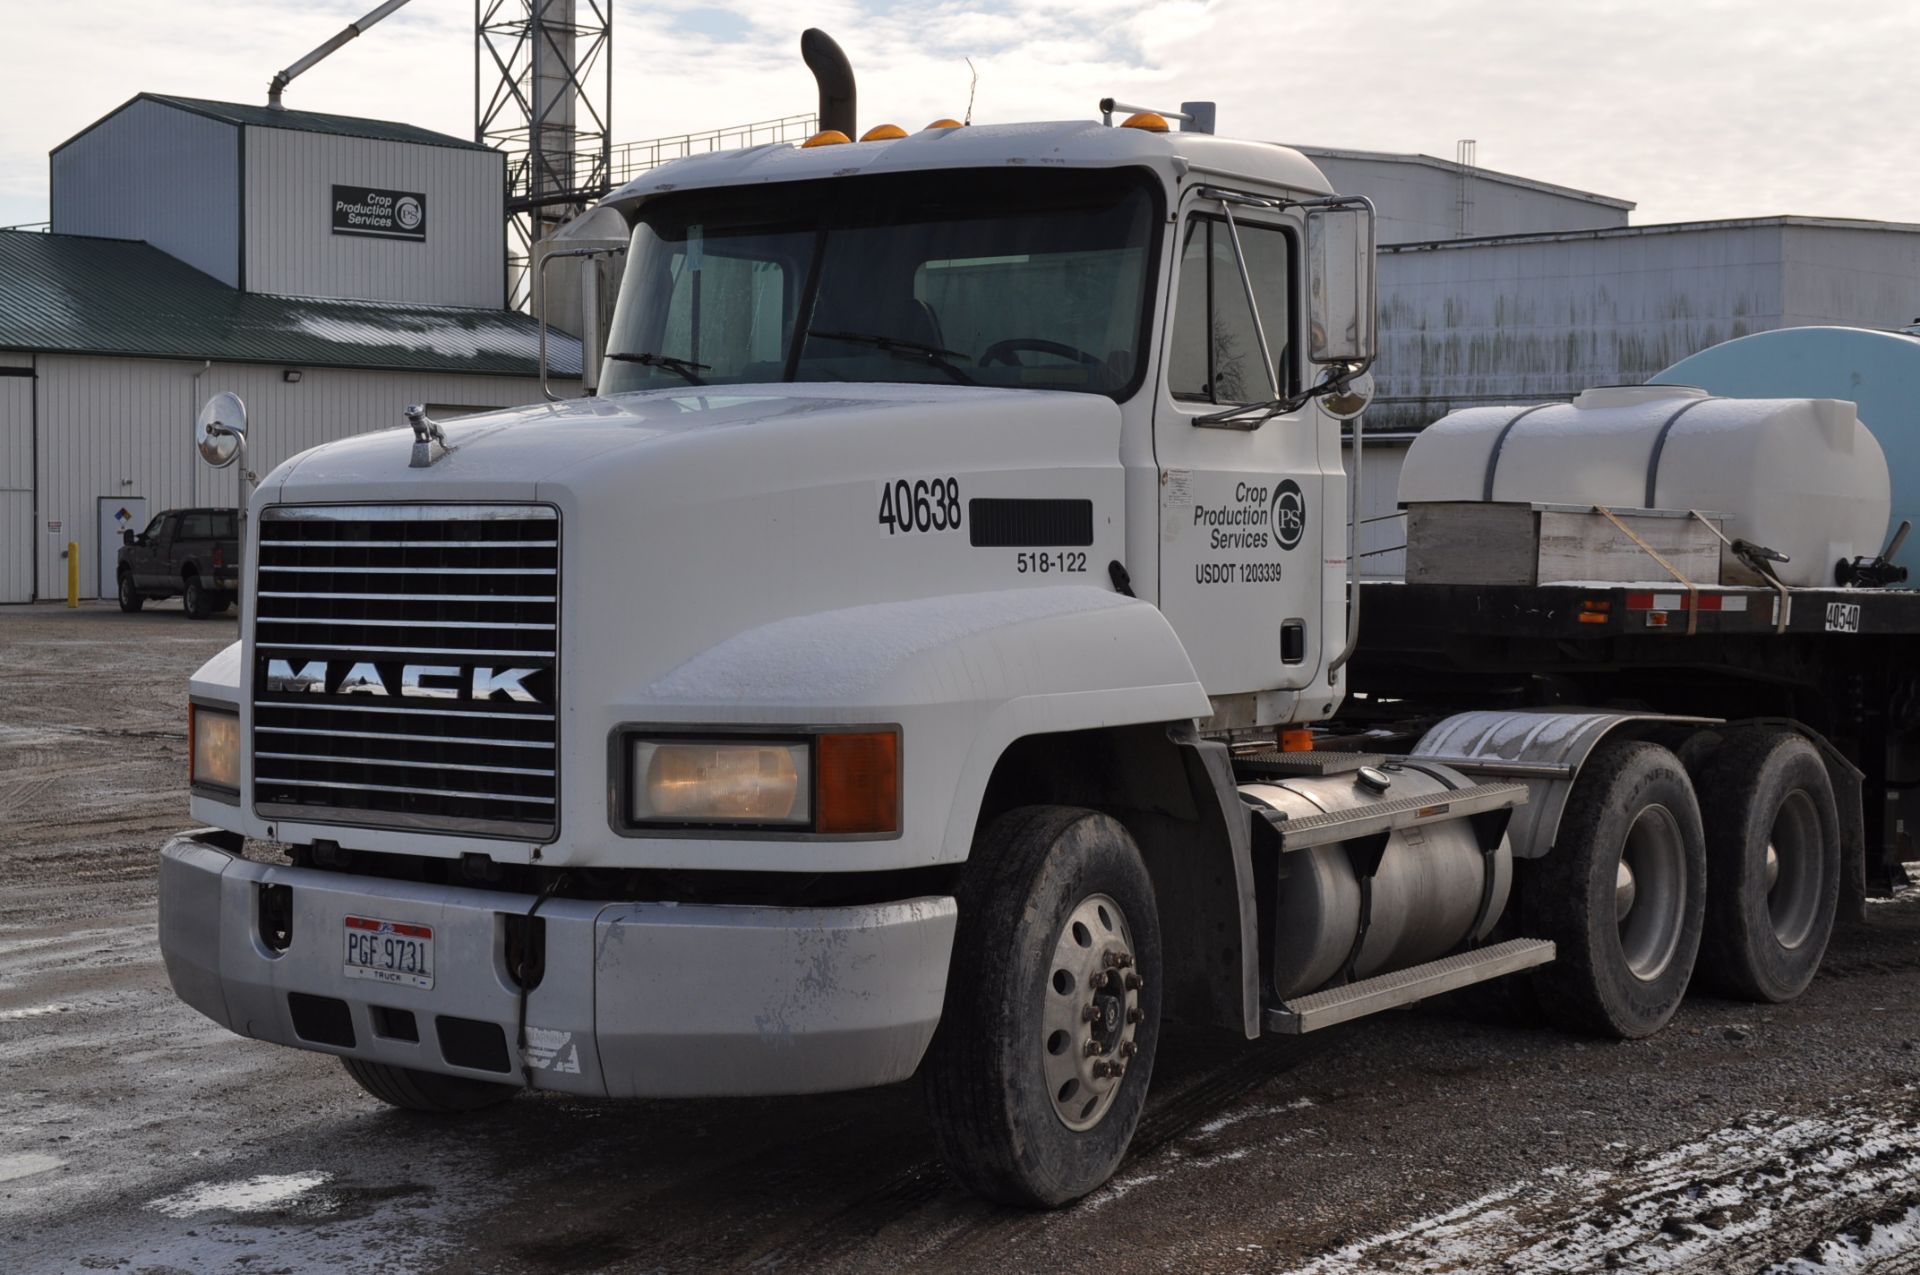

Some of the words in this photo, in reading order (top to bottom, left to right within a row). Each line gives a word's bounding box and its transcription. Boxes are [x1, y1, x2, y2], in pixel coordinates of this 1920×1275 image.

[336, 201, 392, 216] Production
[367, 193, 392, 207] Crop
[347, 213, 392, 227] Services
[1235, 482, 1268, 508] Crop
[879, 477, 961, 535] 40638
[1193, 505, 1268, 526] Production
[1272, 491, 1304, 545] CPS
[1210, 528, 1269, 549] Services
[1017, 552, 1087, 573] 518-122
[1195, 563, 1237, 584] USDOT
[1239, 562, 1282, 583] 1203339
[1826, 604, 1859, 631] 40540
[266, 658, 545, 704] MACK
[348, 933, 378, 965] PGF
[385, 938, 425, 974] 9731
[374, 970, 401, 981] TRUCK
